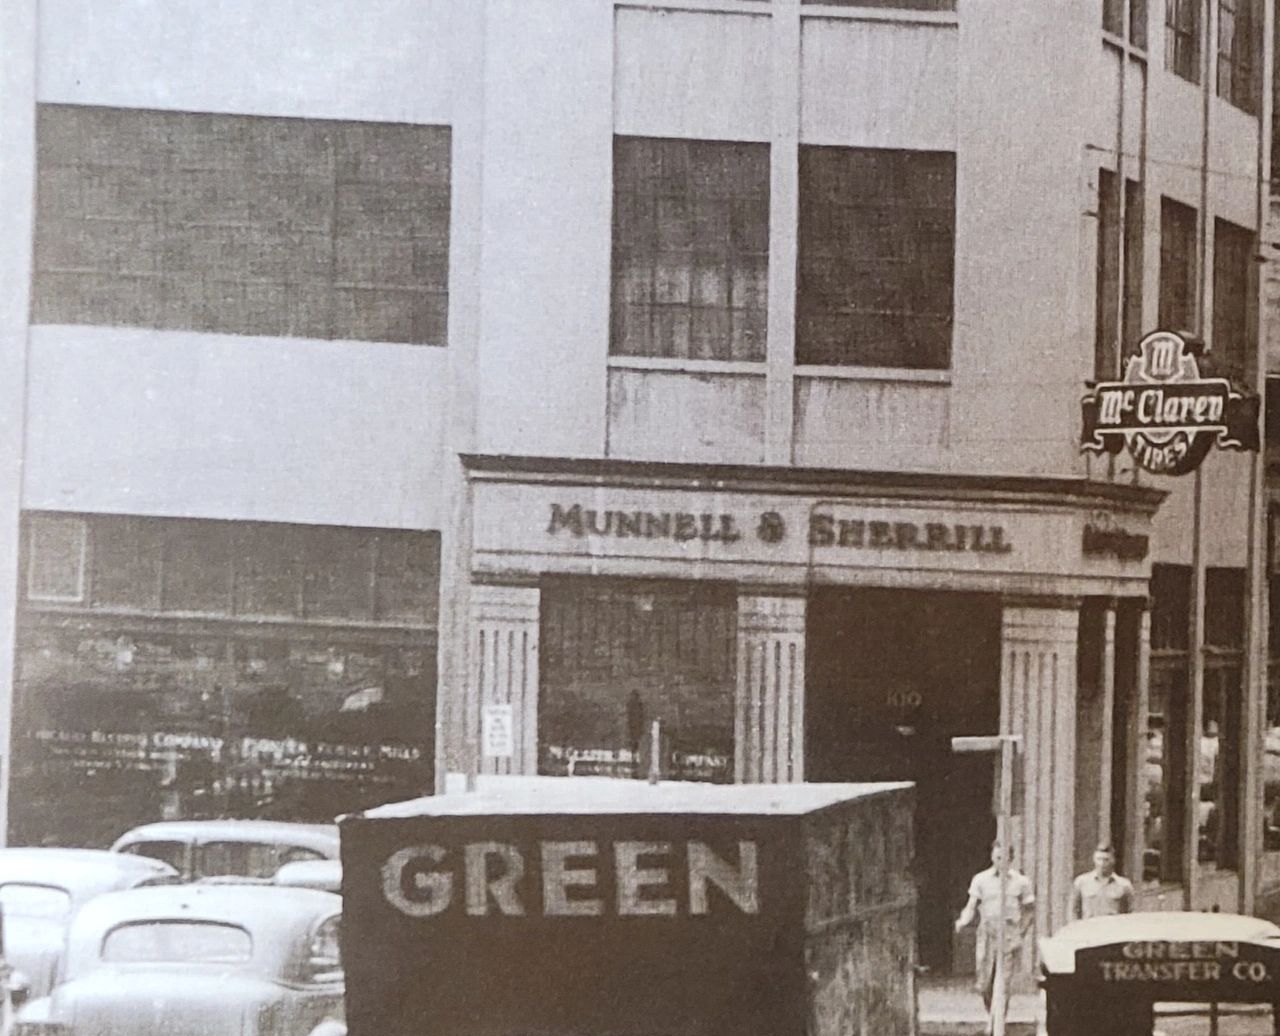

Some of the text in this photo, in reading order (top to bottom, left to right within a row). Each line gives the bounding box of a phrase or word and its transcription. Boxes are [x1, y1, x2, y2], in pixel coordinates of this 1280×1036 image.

[546, 503, 741, 544] MUNNELL
[808, 513, 1012, 554] SHERRILL
[379, 840, 760, 918] GREEN
[1121, 941, 1240, 960] GREEN
[1101, 960, 1222, 982] TRANSFER
